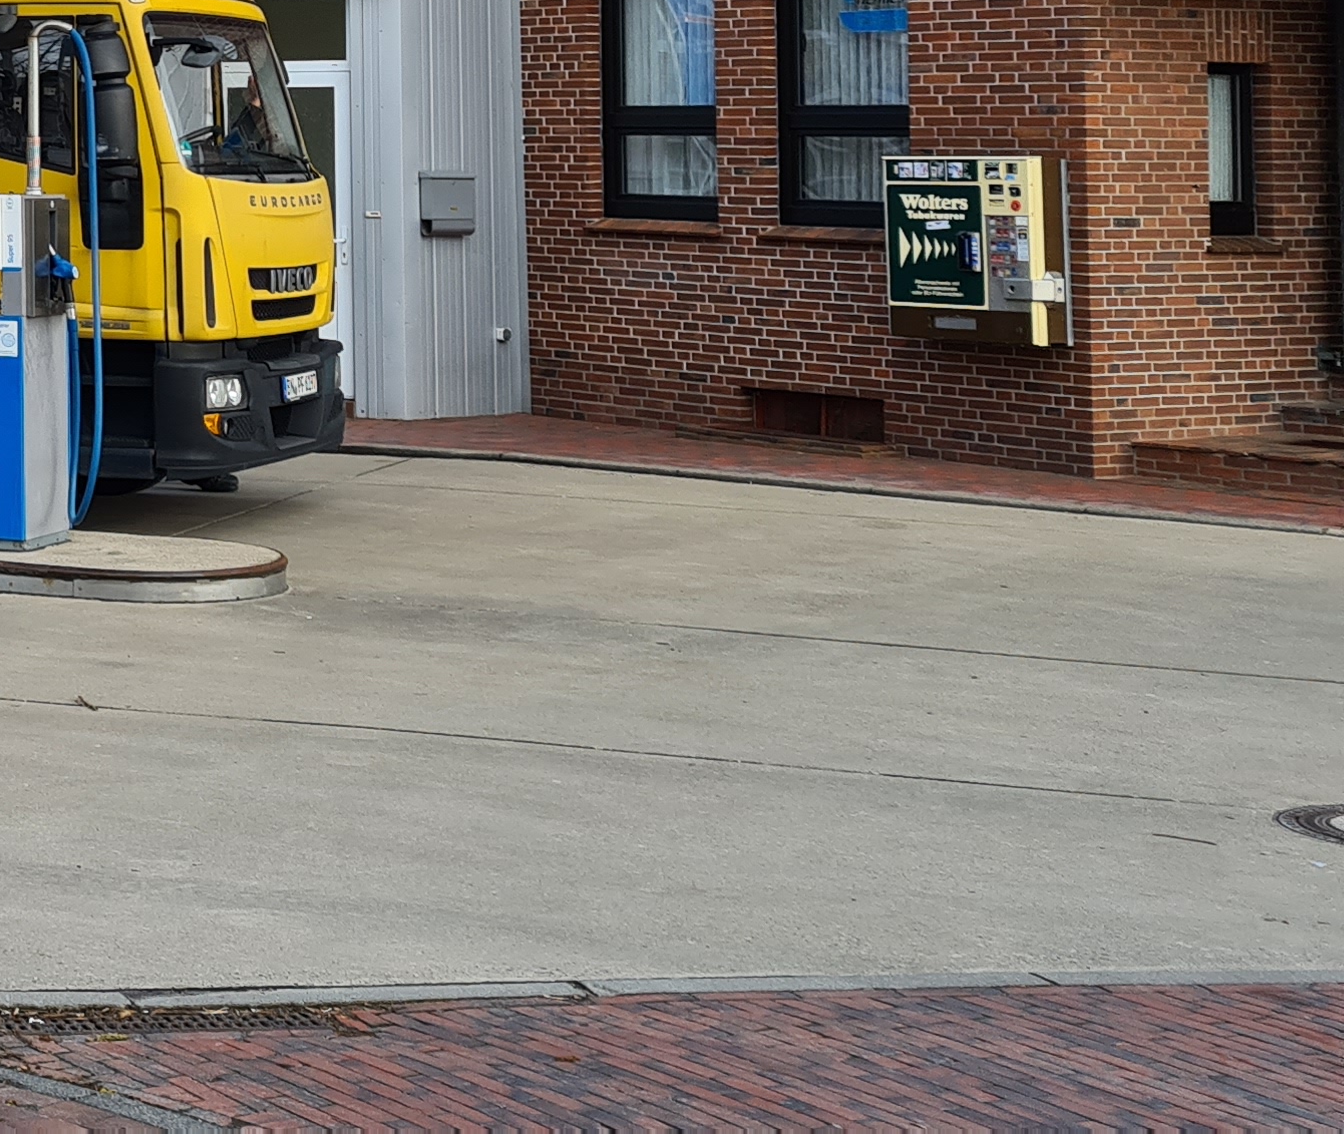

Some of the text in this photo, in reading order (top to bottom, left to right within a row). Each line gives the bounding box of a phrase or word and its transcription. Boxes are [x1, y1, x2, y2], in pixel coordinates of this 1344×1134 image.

[250, 193, 322, 208] EUROCARGO
[898, 193, 969, 211] Wolters
[271, 267, 313, 294] IVECO
